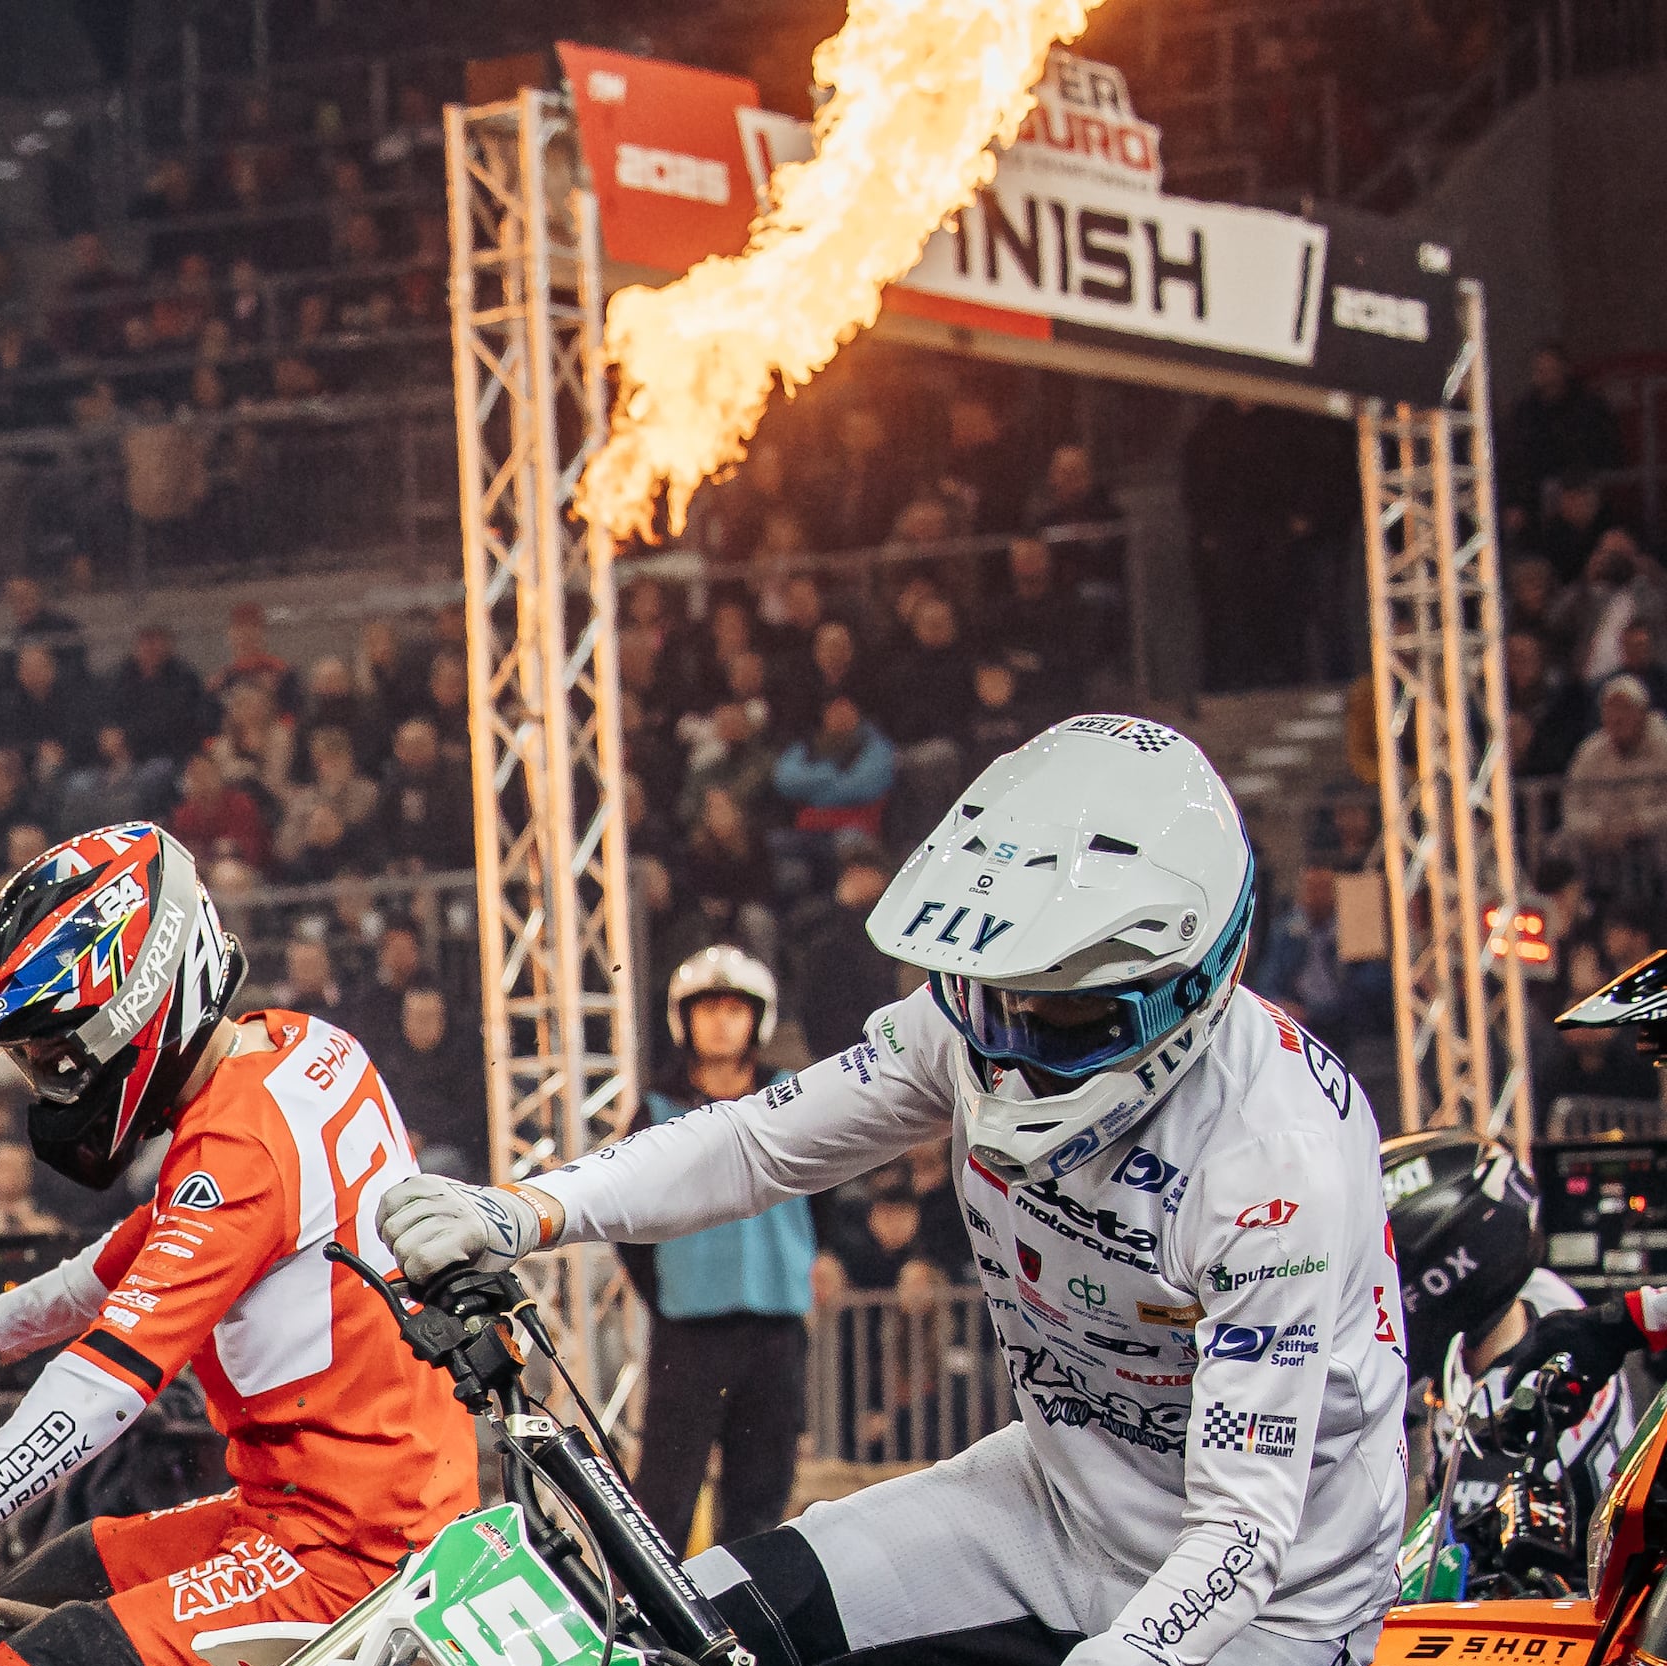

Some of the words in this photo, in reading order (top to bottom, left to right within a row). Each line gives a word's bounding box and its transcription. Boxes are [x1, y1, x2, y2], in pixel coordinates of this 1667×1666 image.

[950, 188, 1207, 323] INISH
[94, 874, 144, 920] 24
[902, 901, 1015, 954] FLY
[109, 898, 185, 1038] AIRSCREEN
[1135, 1028, 1193, 1092] FLY
[1234, 1252, 1329, 1290] putzdeibel
[1403, 1246, 1480, 1314] FOX
[1282, 1324, 1316, 1338] ADAC
[1271, 1354, 1304, 1367] Sport
[1255, 1443, 1294, 1458] GERMANY
[1258, 1424, 1296, 1446] TEAM
[579, 1458, 626, 1511] Racing
[622, 1511, 698, 1602] Suspension
[1462, 1637, 1577, 1658] SHOT
